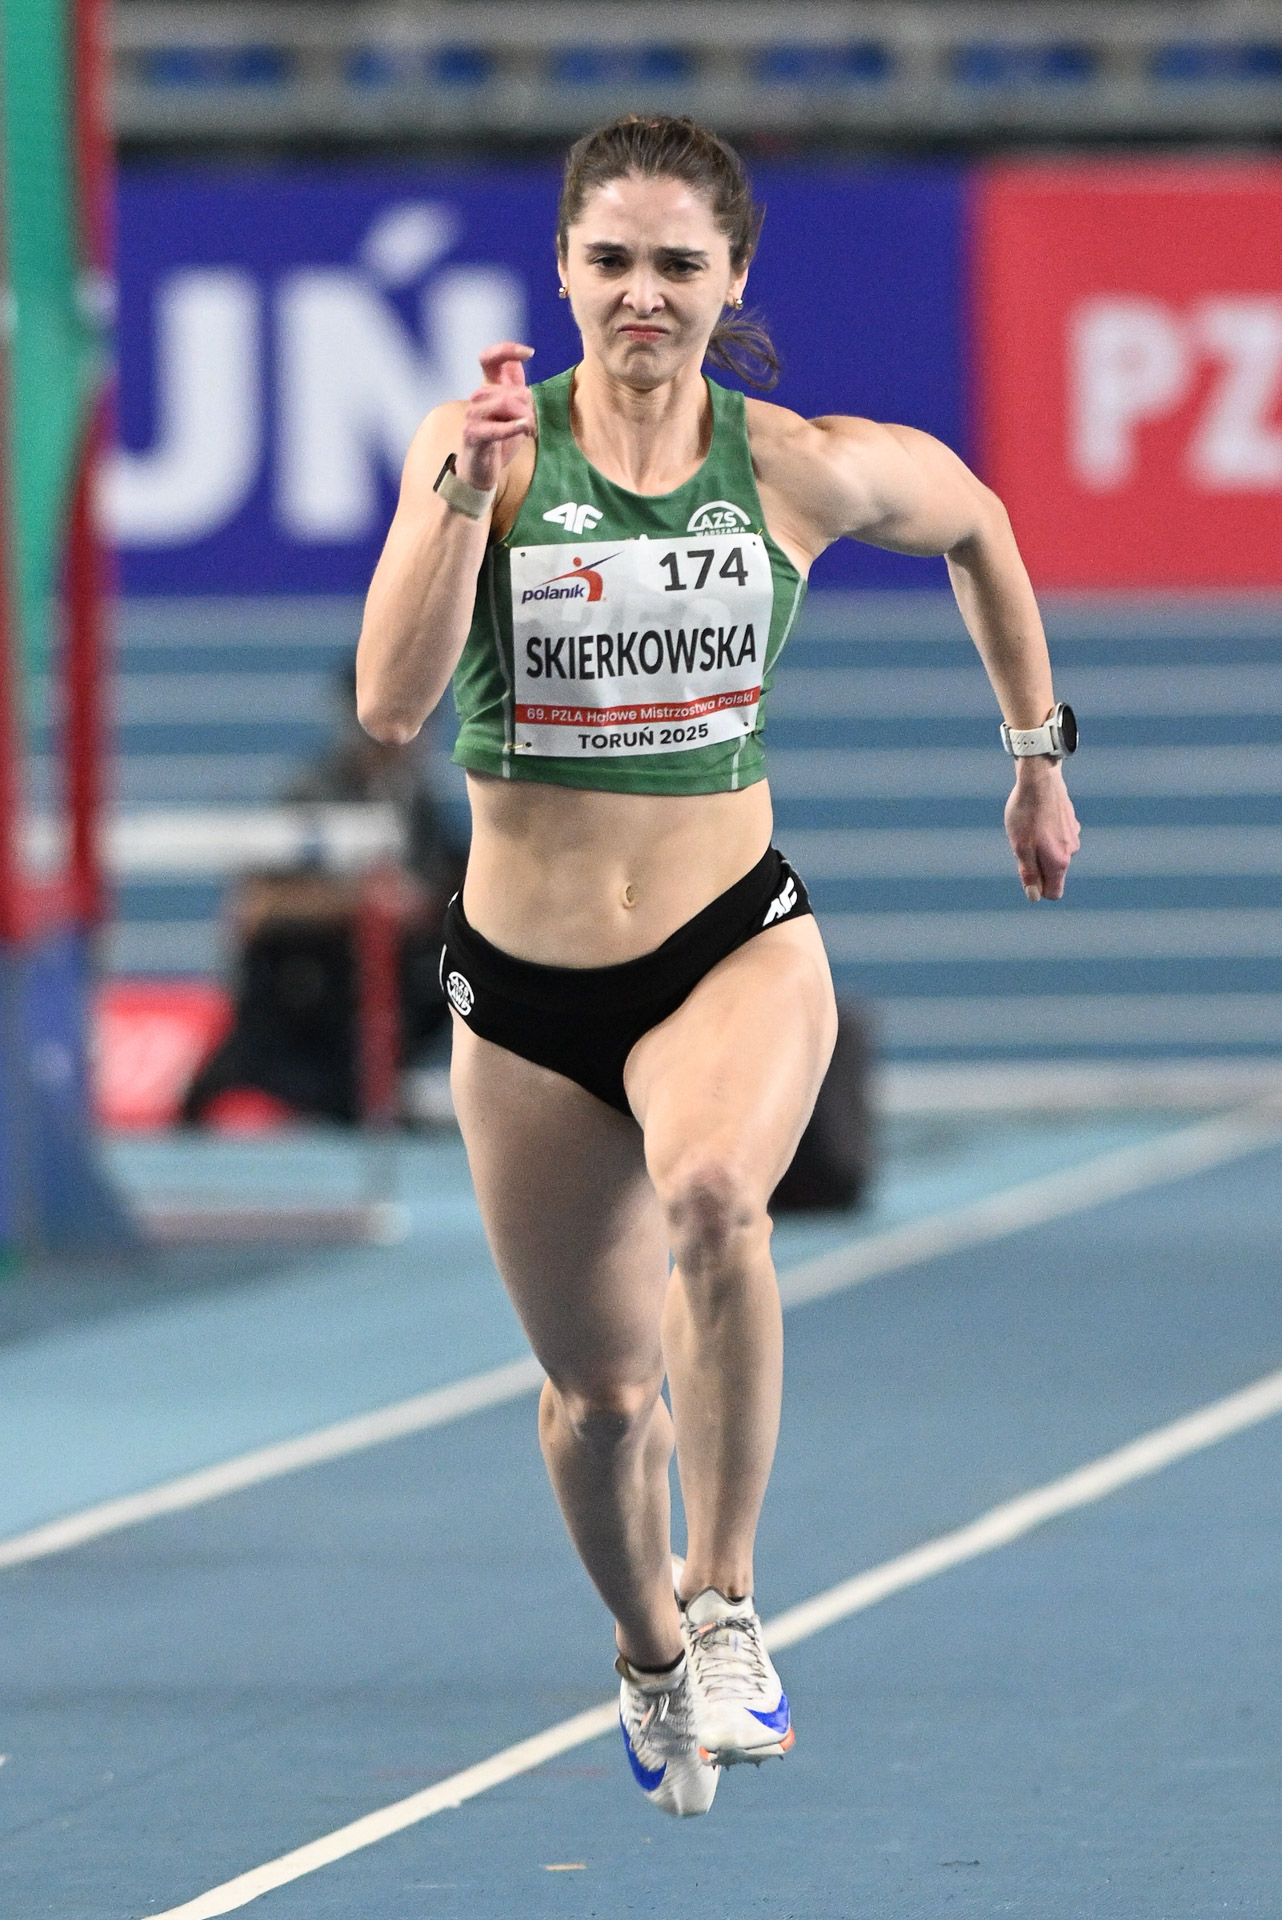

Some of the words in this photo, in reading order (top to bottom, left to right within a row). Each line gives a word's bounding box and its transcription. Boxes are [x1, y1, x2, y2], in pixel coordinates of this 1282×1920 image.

[1070, 296, 1282, 494] PZ
[543, 502, 603, 534] 4F
[701, 511, 737, 529] AZS
[659, 547, 748, 592] 174
[521, 584, 585, 604] polanik
[525, 623, 757, 680] SKIERKOWSKA
[527, 708, 548, 721] 69.
[551, 709, 583, 723] PZLA
[587, 710, 637, 723] Halowe
[640, 700, 715, 719] Mistrzostwa
[718, 691, 753, 707] Polski
[578, 726, 654, 749] TORUŃ
[660, 723, 708, 745] 2025
